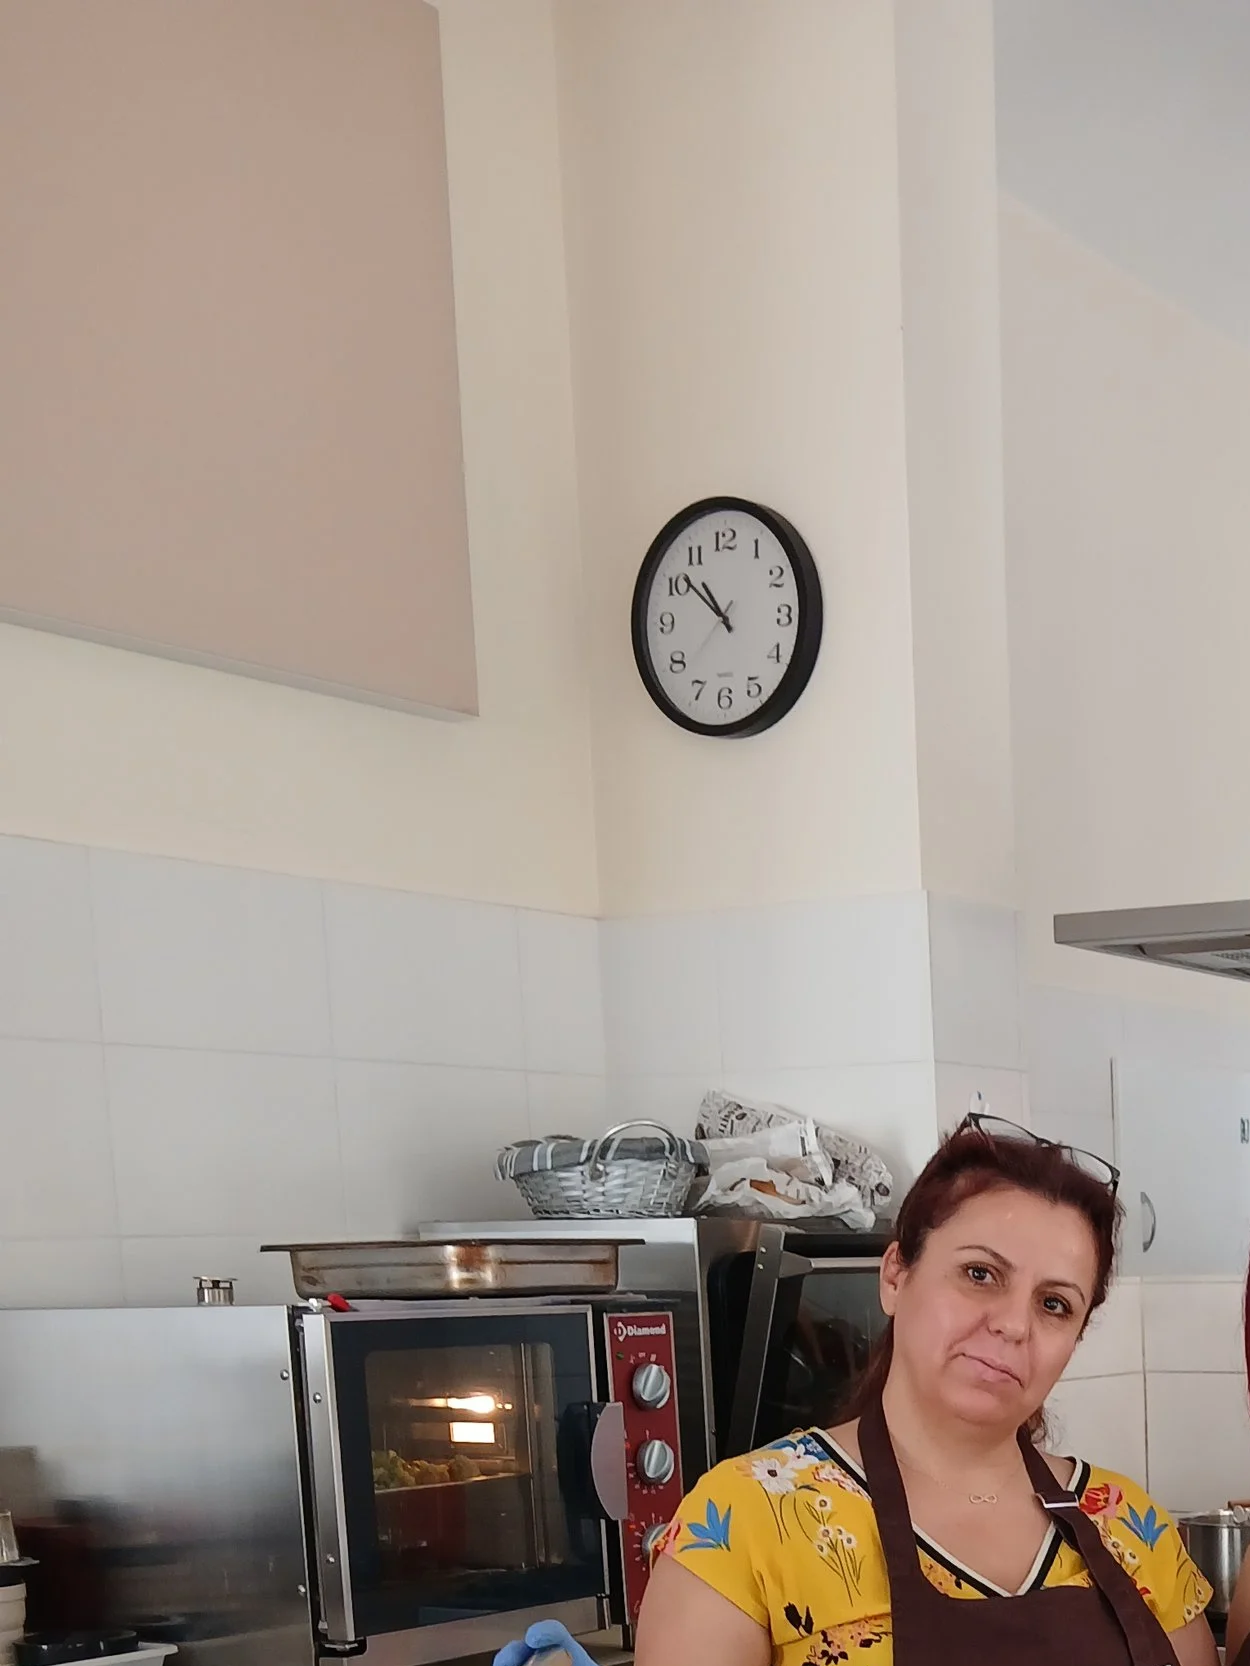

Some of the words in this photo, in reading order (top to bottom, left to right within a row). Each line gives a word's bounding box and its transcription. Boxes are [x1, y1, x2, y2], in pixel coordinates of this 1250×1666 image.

[714, 527, 738, 552] 12
[753, 538, 760, 559] 1
[687, 545, 703, 566] 11
[668, 572, 690, 597] 10
[768, 565, 785, 588] 2
[659, 611, 675, 635] 9
[776, 603, 793, 627] 3
[669, 650, 687, 674] 8
[766, 642, 782, 664] 4
[691, 679, 707, 701] 7
[717, 686, 733, 710] 6
[746, 676, 762, 699] 5
[626, 1323, 666, 1337] Diamond
